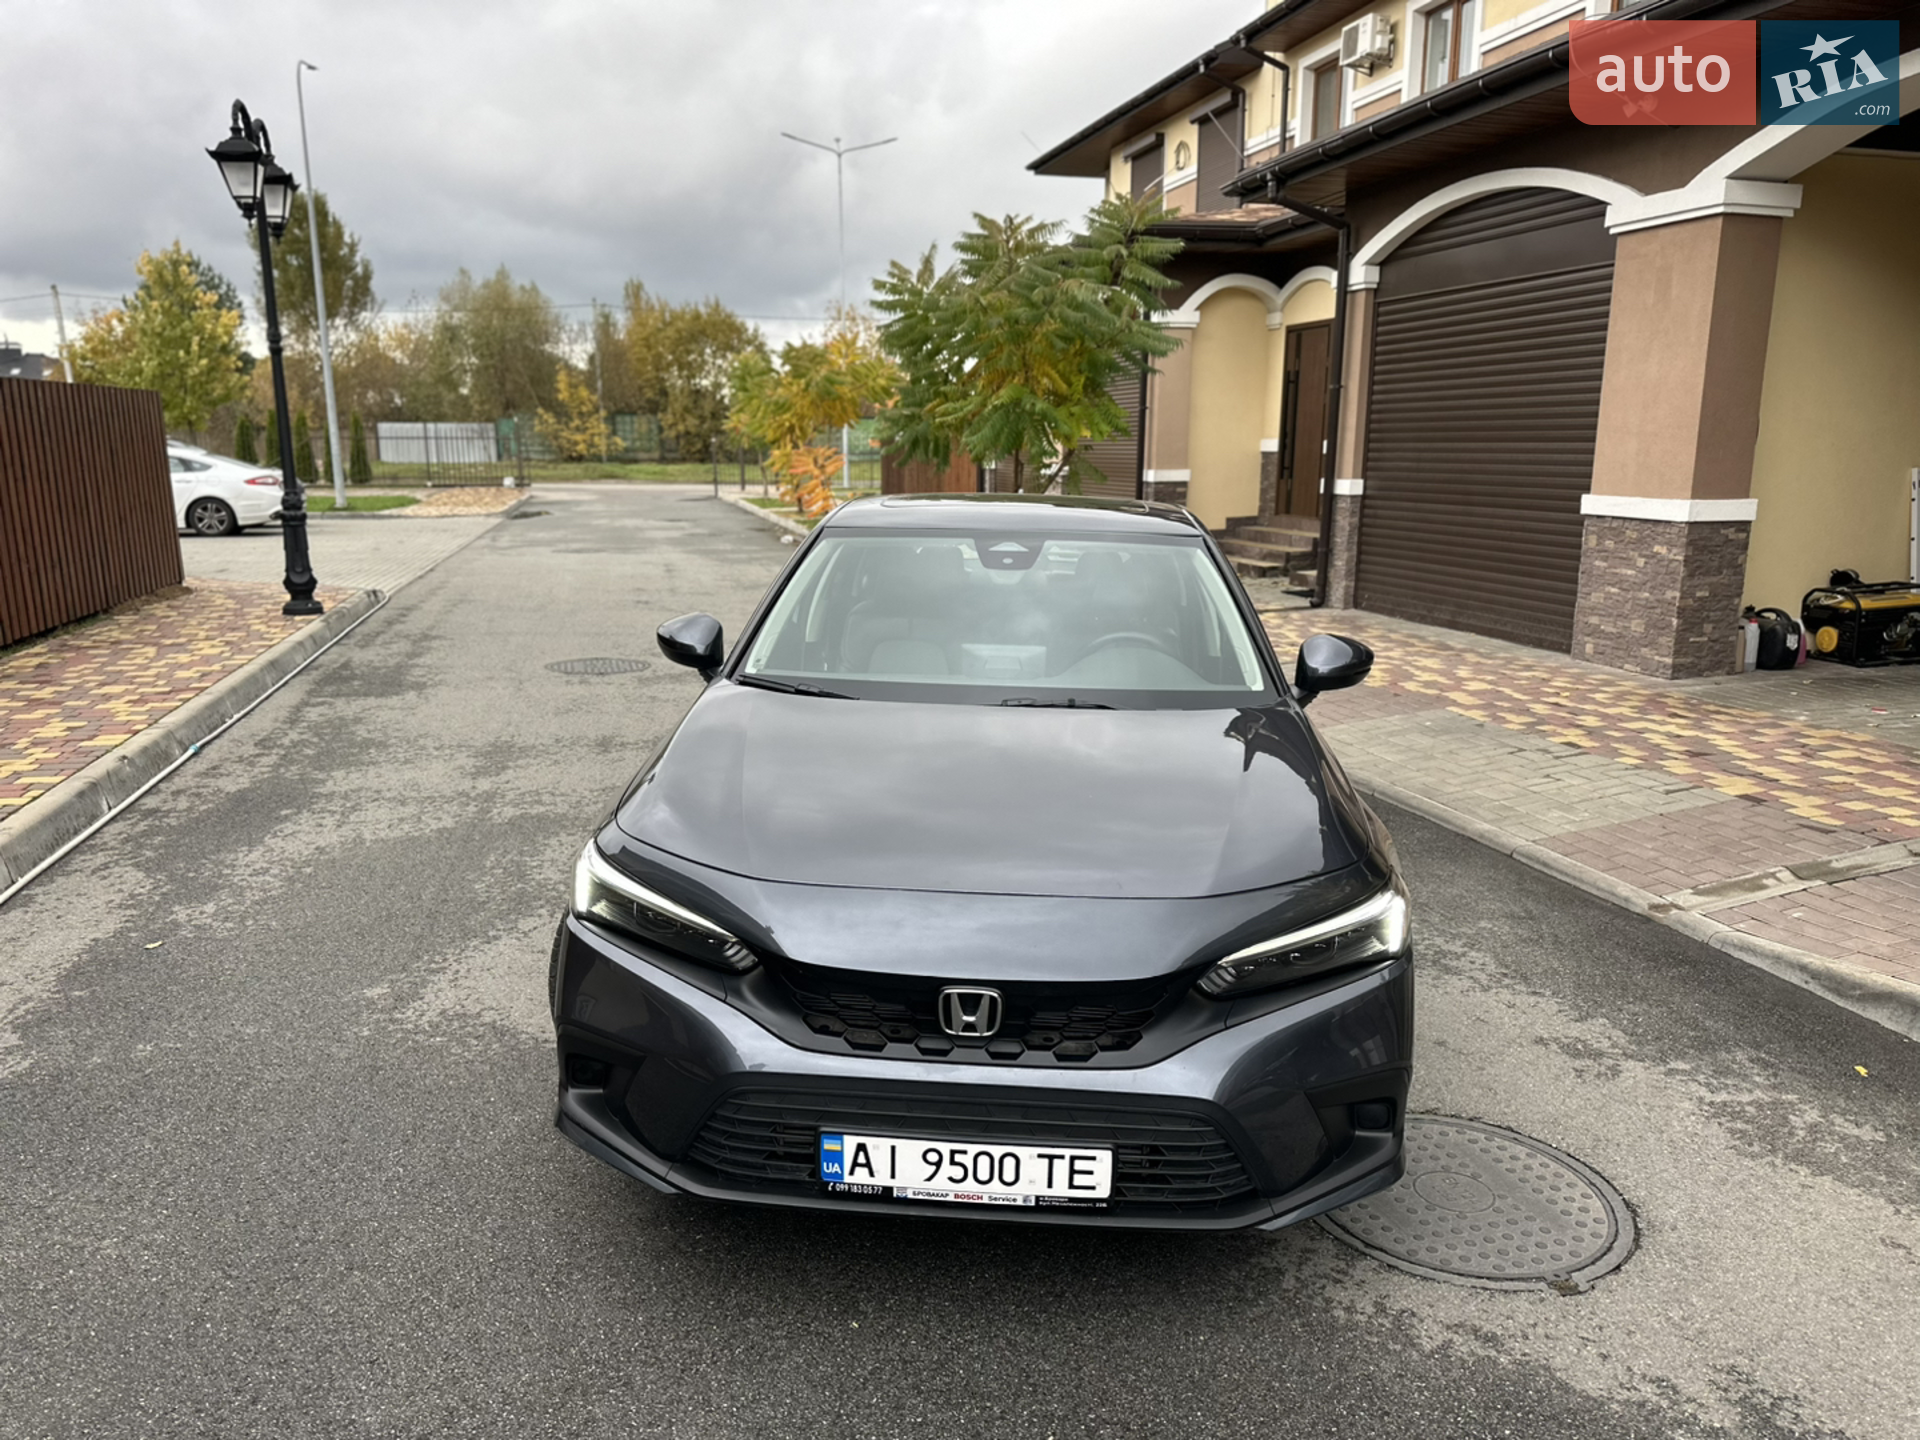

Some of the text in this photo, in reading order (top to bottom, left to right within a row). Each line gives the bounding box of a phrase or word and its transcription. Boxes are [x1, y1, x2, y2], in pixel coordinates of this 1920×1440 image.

[823, 1162, 842, 1175] UA
[848, 1142, 1097, 1191] AI 9500 TE
[953, 1192, 984, 1201] BOSCH
[987, 1194, 1018, 1204] Service
